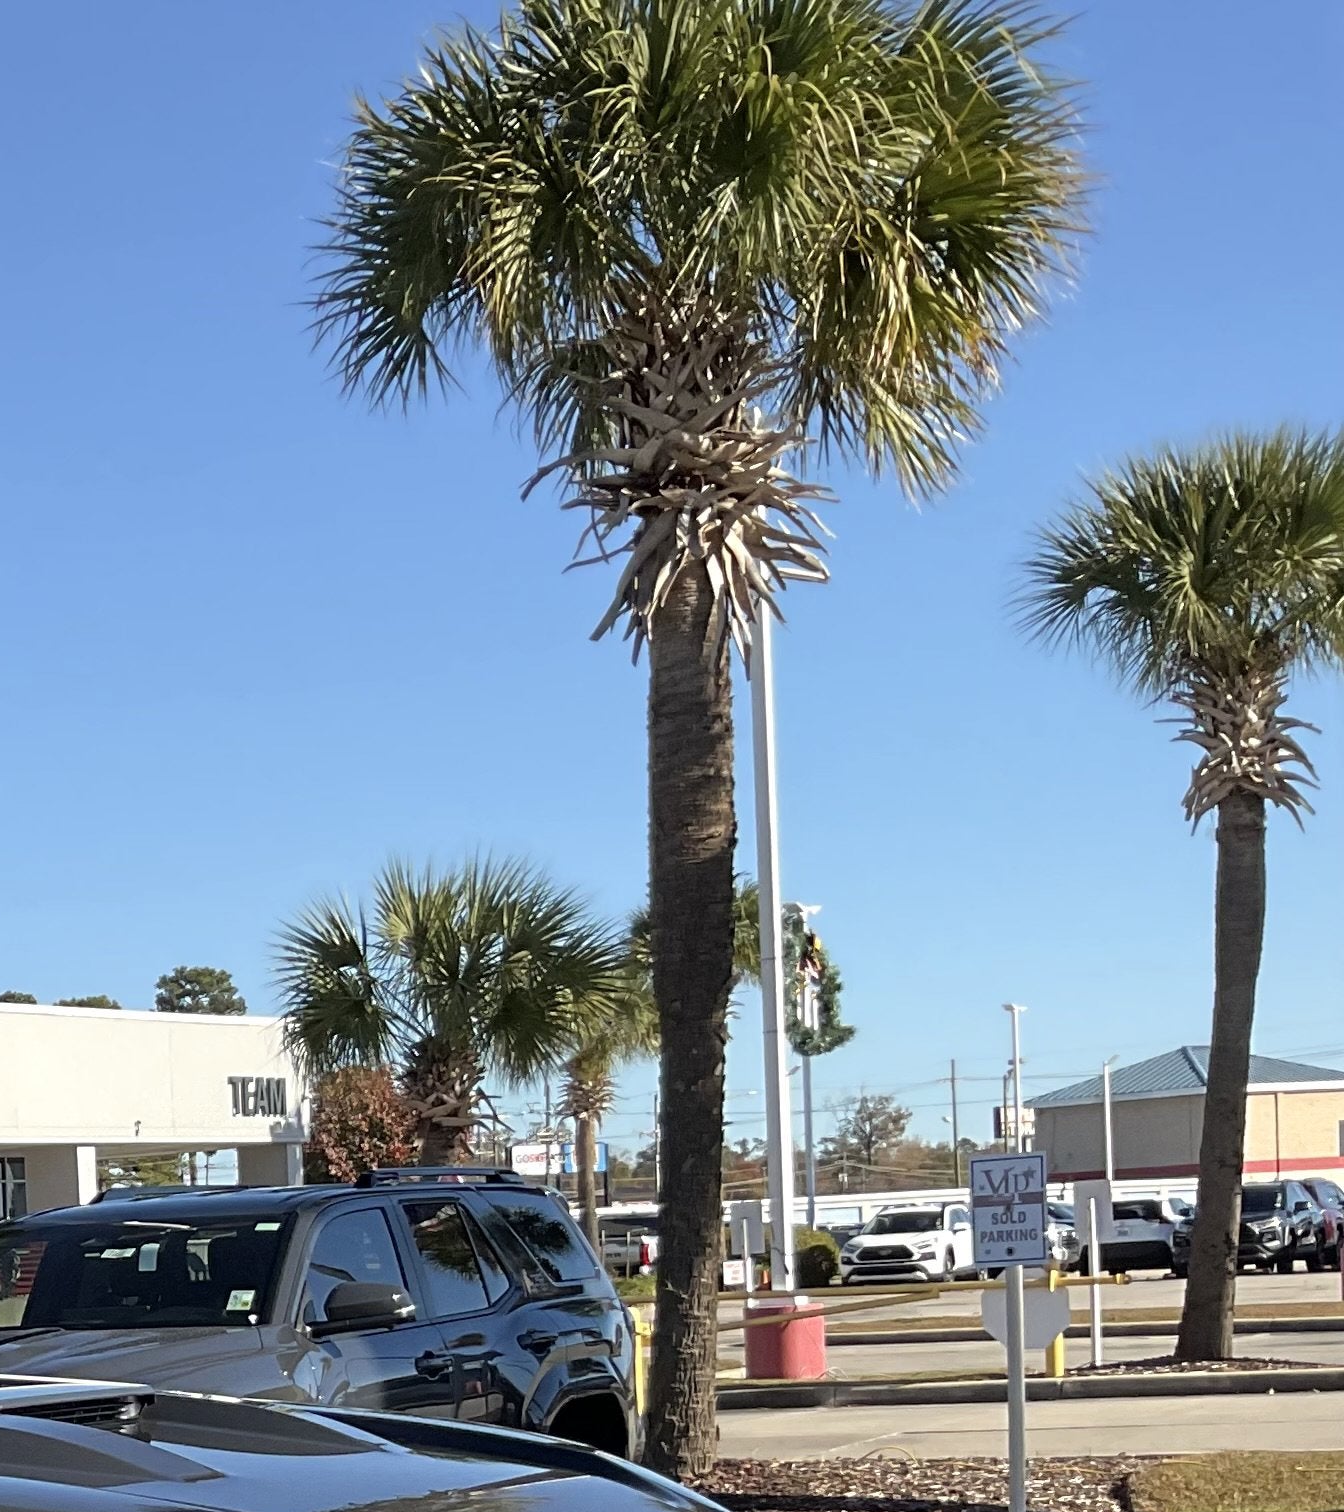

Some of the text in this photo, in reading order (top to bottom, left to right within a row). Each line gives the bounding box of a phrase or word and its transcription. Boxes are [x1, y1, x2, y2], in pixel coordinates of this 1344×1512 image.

[227, 1076, 287, 1117] TEAM
[991, 1211, 1027, 1226] SOLD
[980, 1228, 1039, 1243] PARKING
